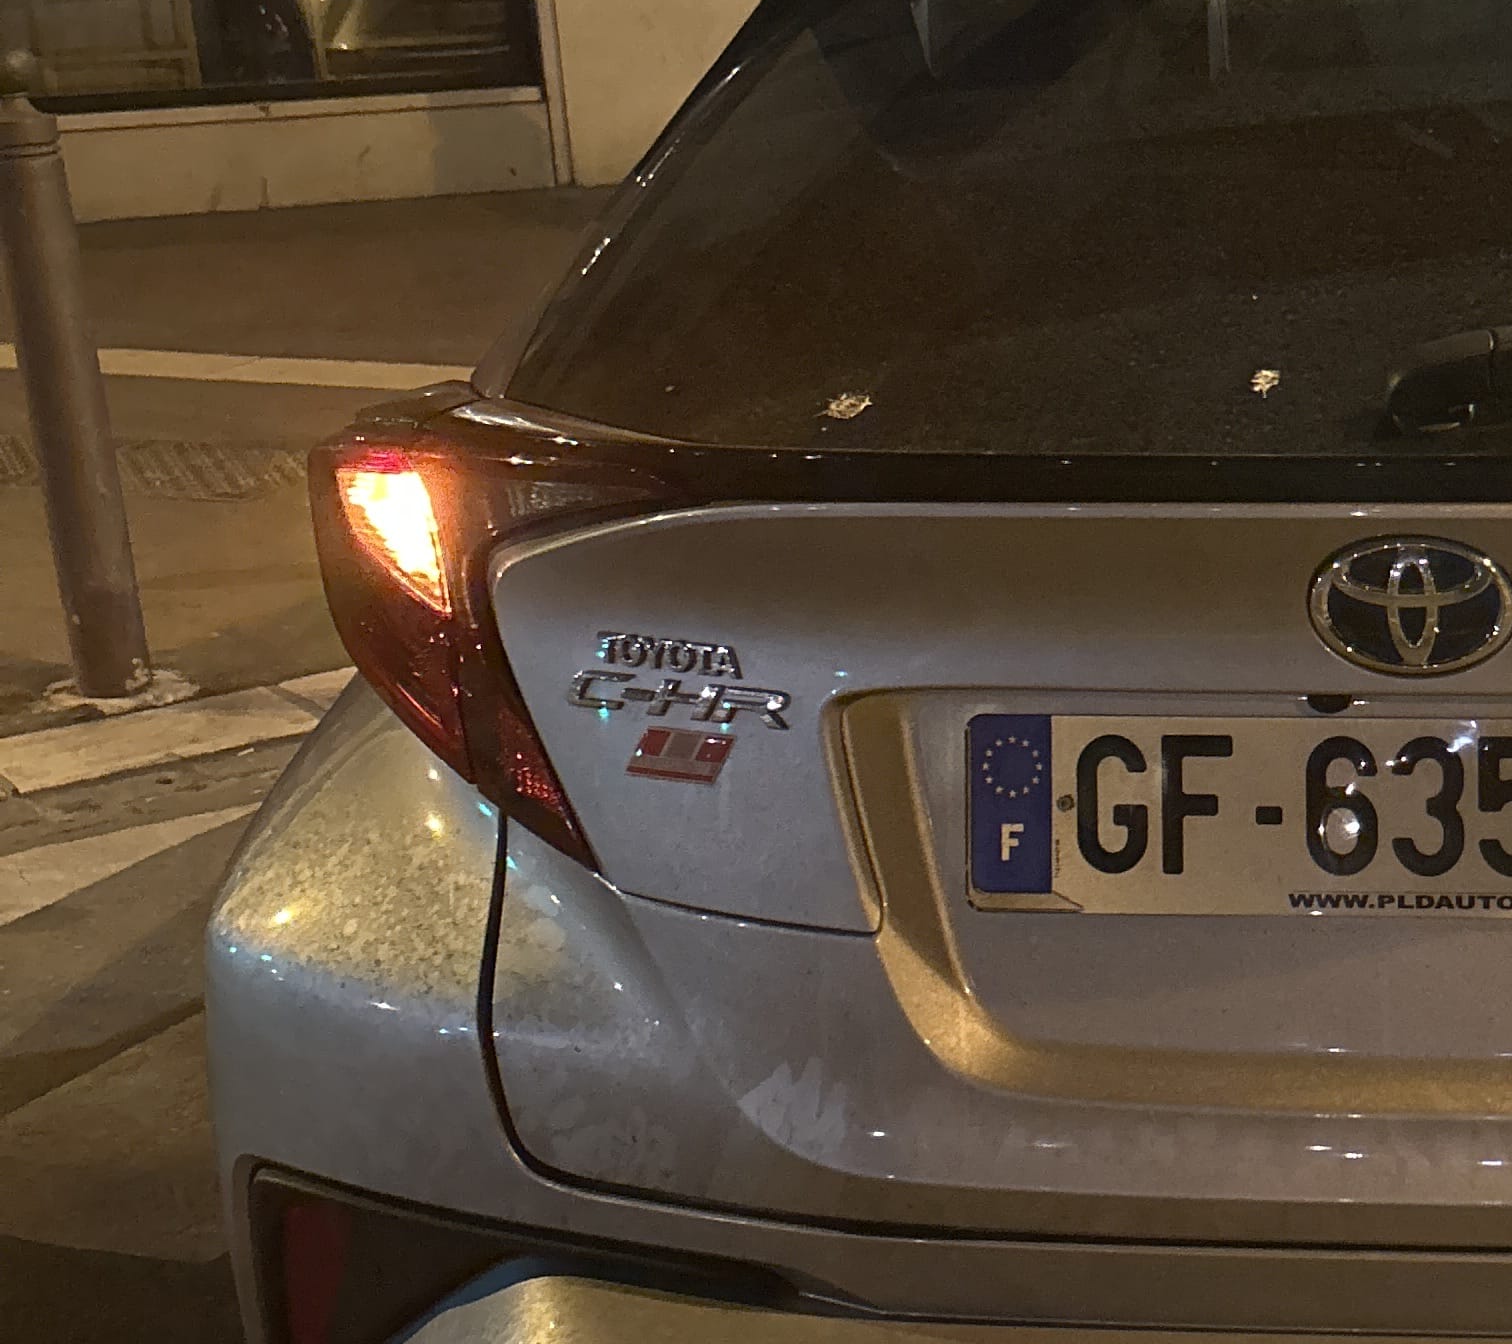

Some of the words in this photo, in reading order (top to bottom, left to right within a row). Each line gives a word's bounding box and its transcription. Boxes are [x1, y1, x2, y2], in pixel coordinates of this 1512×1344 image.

[597, 630, 743, 679] TOYOTA
[567, 669, 792, 730] C-HR
[1000, 823, 1025, 862] F
